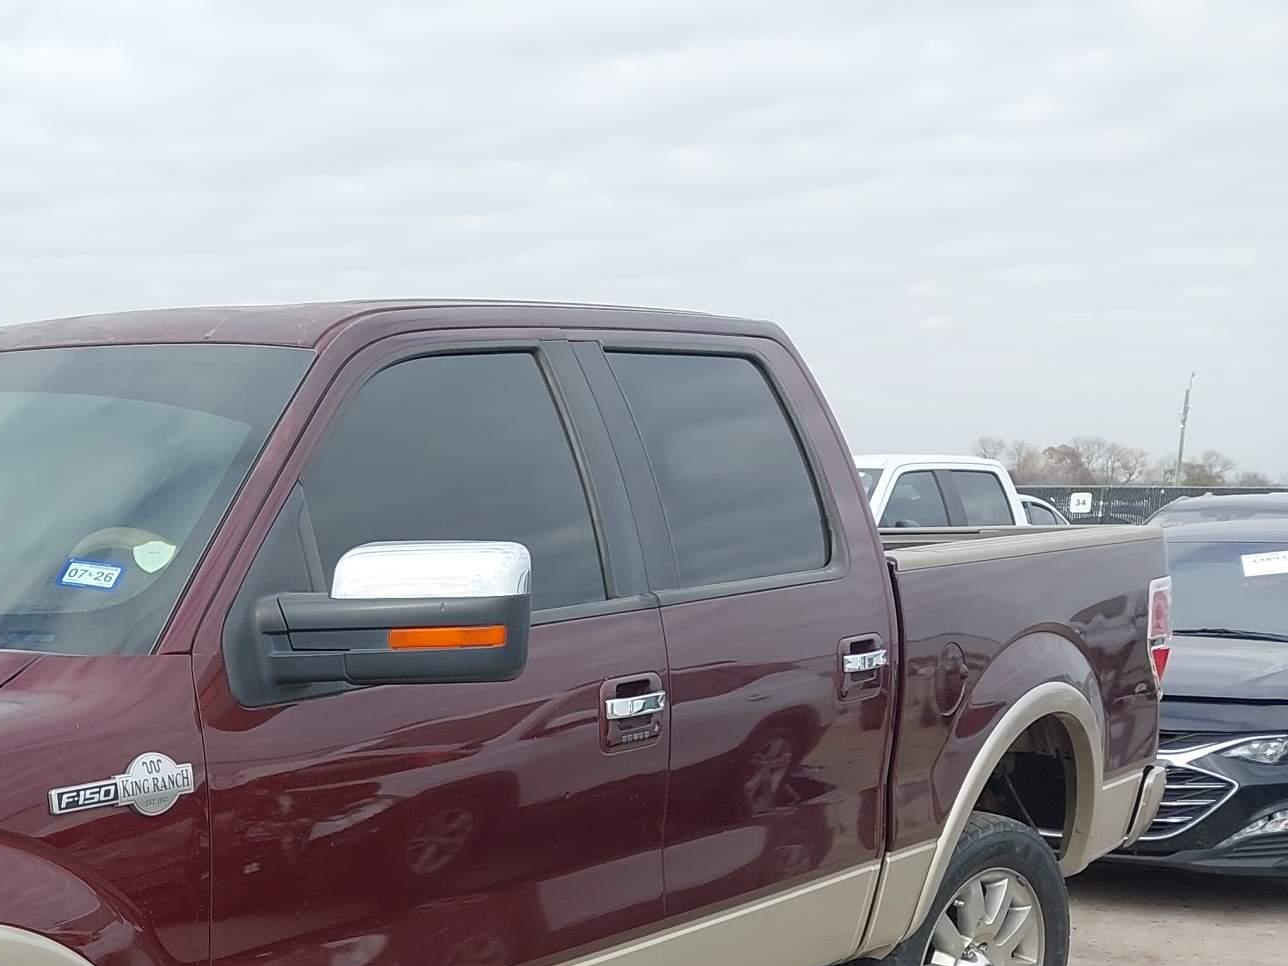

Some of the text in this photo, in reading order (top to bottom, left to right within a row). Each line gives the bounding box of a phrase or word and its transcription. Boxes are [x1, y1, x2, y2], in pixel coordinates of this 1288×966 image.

[122, 769, 190, 798] KING RANCH
[60, 785, 116, 809] F-150
